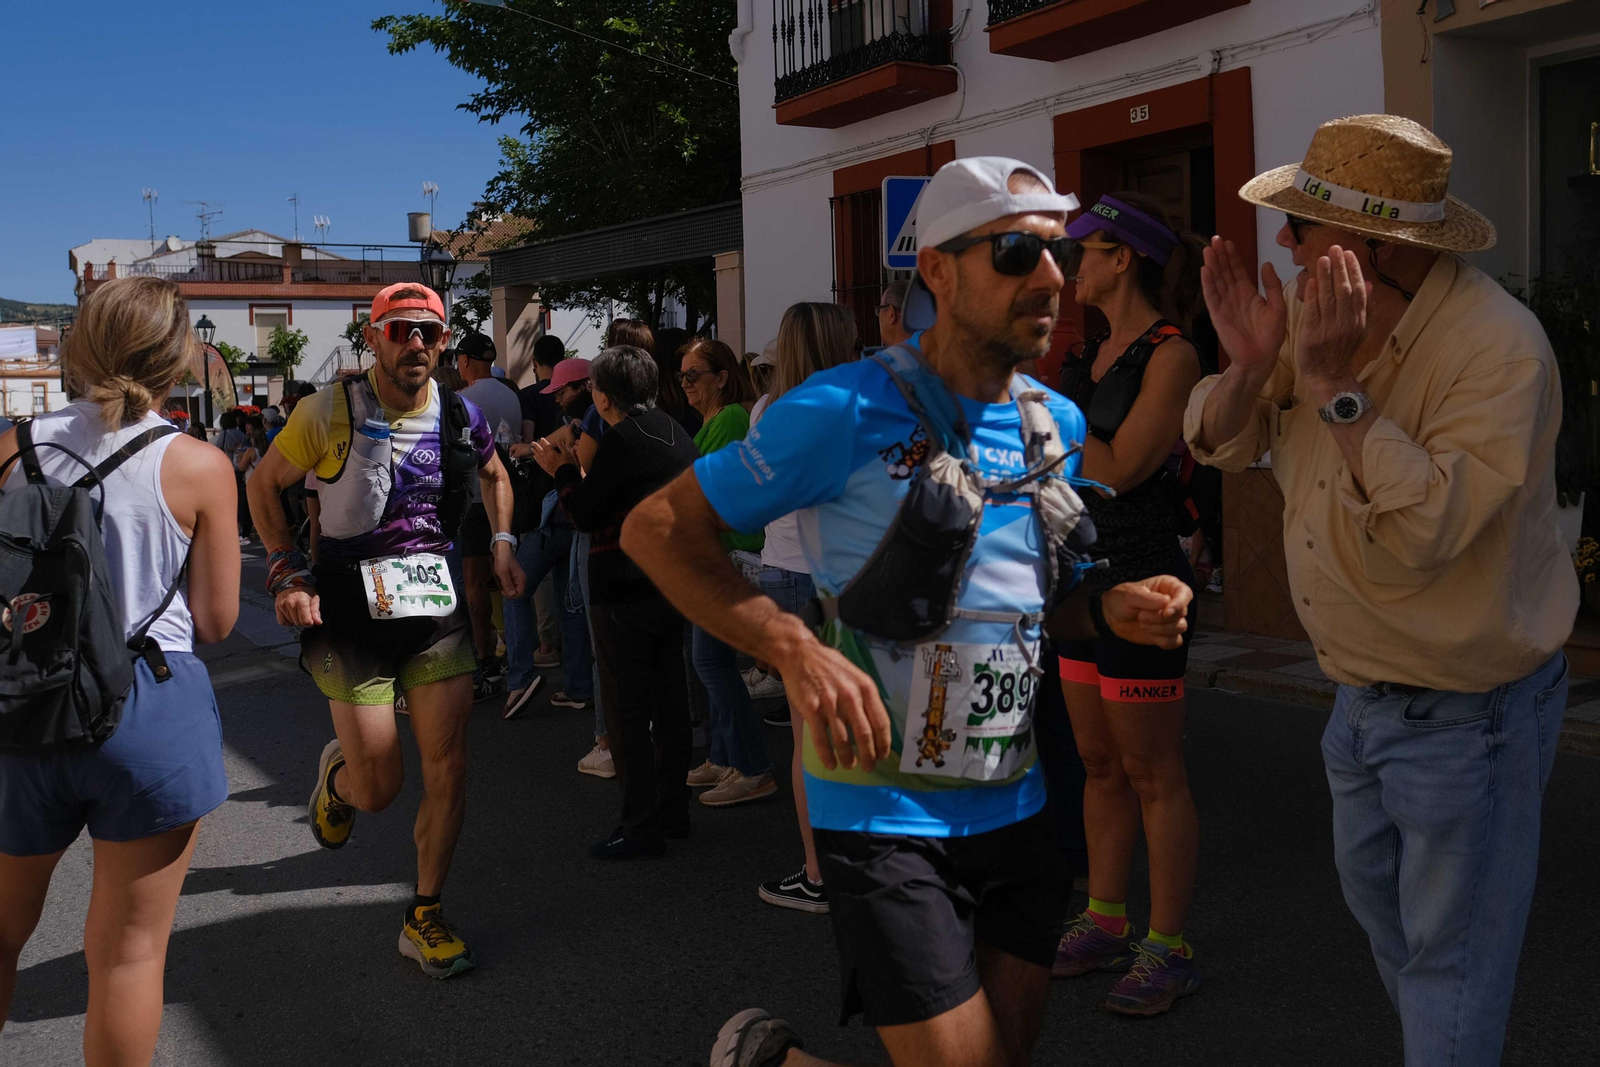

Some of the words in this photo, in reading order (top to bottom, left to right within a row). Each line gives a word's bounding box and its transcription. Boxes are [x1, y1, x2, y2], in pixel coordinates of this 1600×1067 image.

[1131, 106, 1147, 121] 35
[1091, 203, 1119, 220] NKER
[402, 564, 441, 584] 103
[971, 672, 1031, 714] 389
[1120, 685, 1177, 698] HANKER
